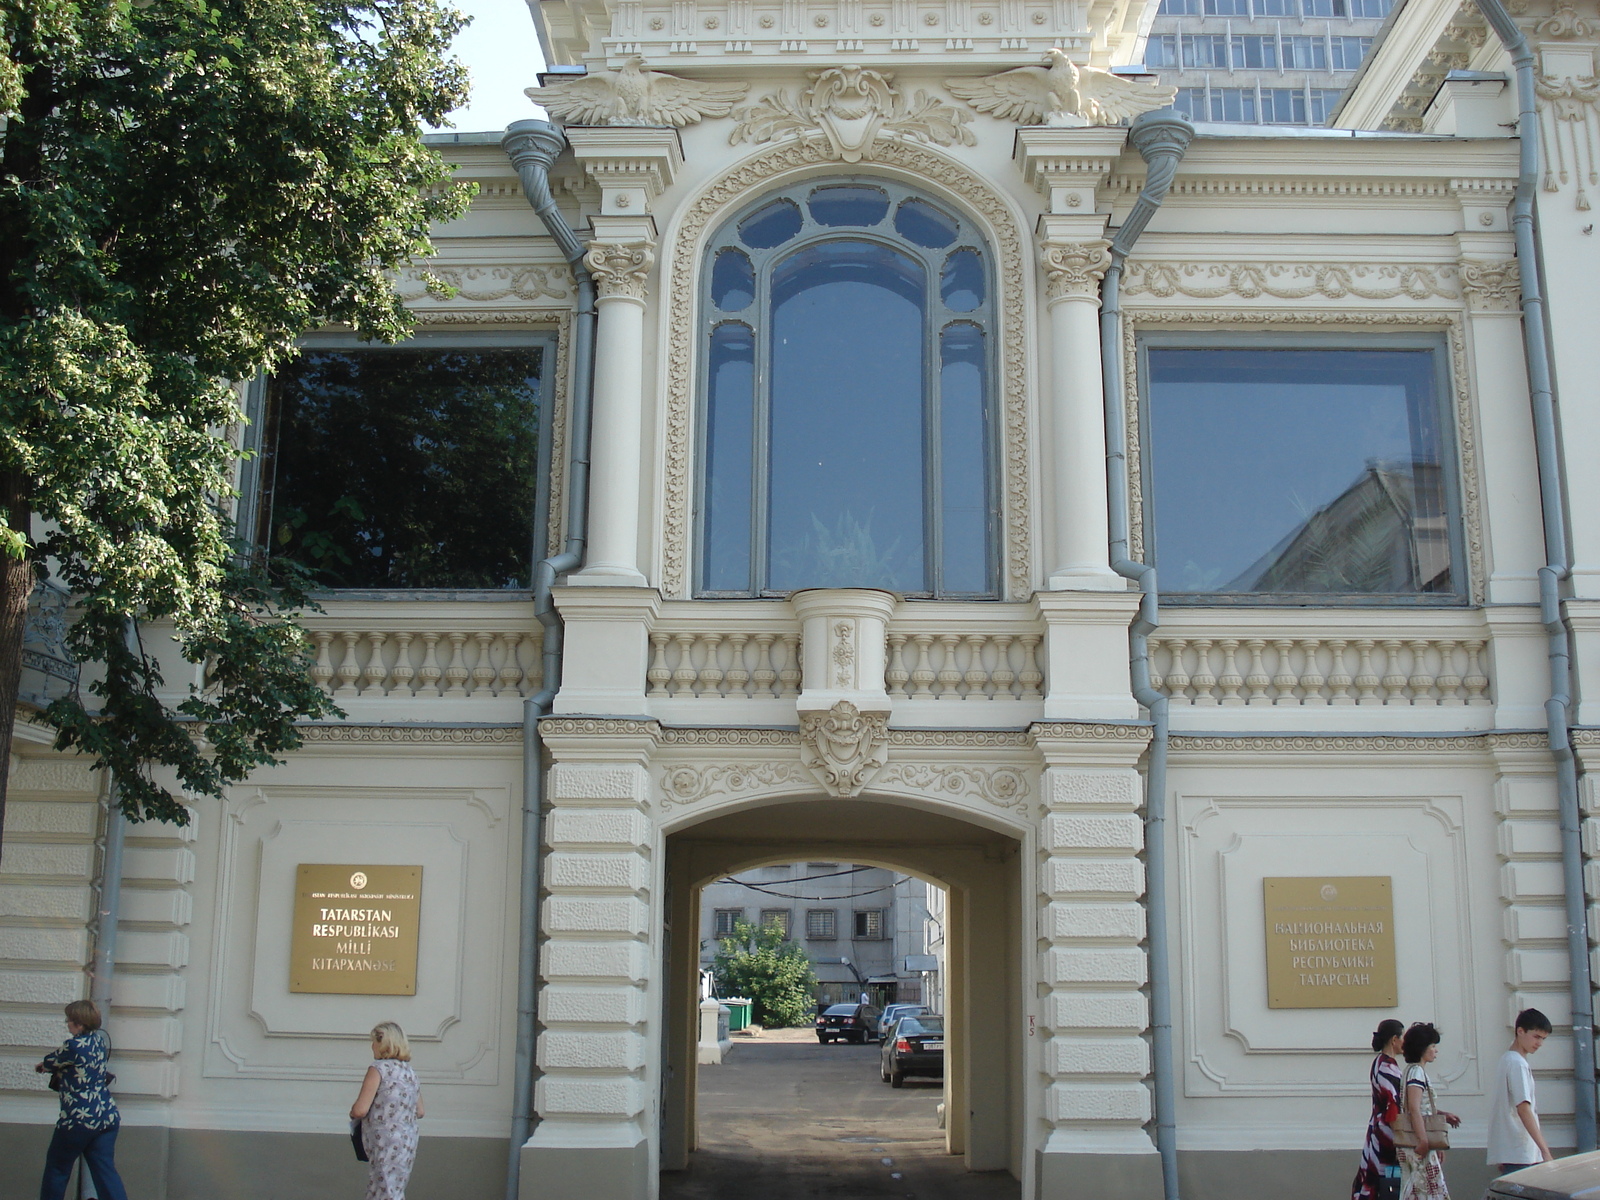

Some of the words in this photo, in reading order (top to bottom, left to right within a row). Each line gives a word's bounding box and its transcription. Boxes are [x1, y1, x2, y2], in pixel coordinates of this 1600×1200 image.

[320, 908, 392, 922] TATARSTAN
[312, 923, 399, 938] RESPUBLİKASI
[1274, 921, 1384, 935] НАЦИОНАЛЬНАЯ
[336, 939, 372, 955] MİLLİ
[1289, 938, 1375, 952] БИБЛИОТЕКА
[1292, 955, 1374, 969] РЕСПУБЛИКИ
[1299, 972, 1371, 986] ТАТАРСТАН
